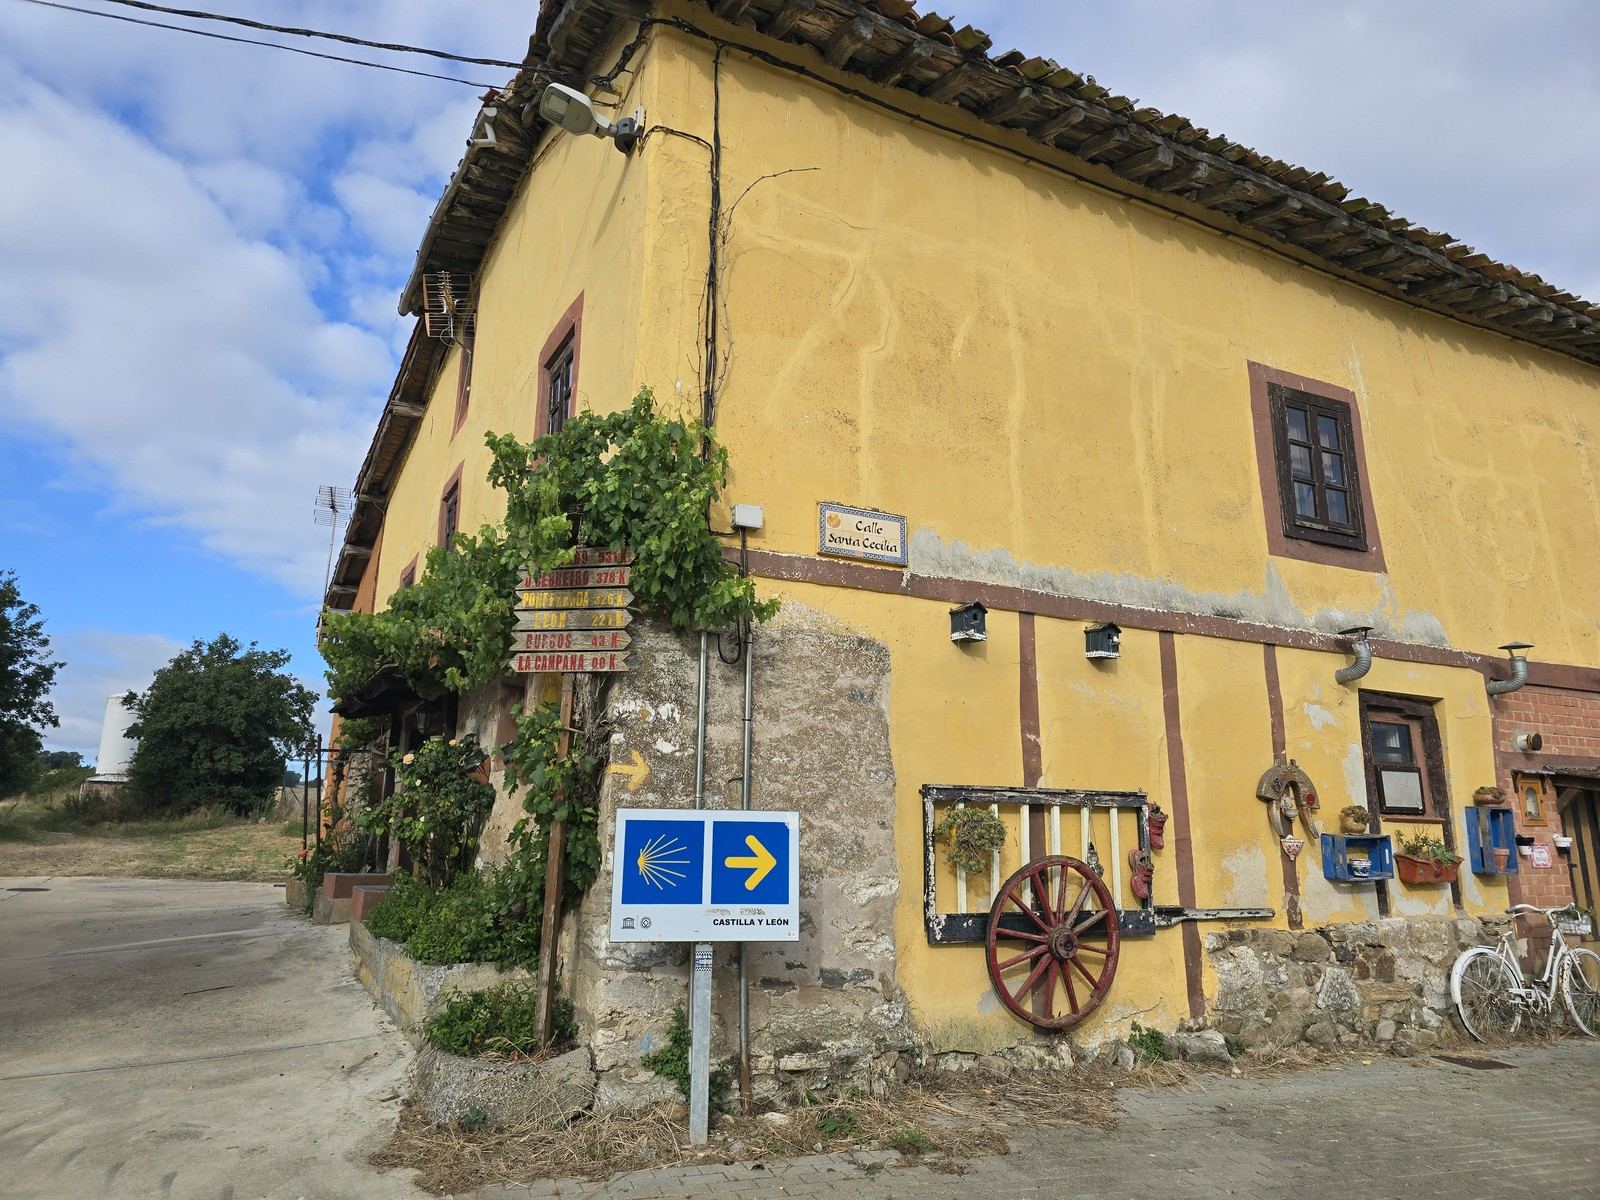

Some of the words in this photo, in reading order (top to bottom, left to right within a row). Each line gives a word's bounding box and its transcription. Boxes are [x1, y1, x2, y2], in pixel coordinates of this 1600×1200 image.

[856, 520, 883, 535] Calle
[828, 533, 861, 547] Santa
[862, 537, 898, 553] Cecilia
[596, 571, 616, 584] 378
[619, 569, 625, 584] K
[617, 591, 624, 605] K
[533, 612, 568, 628] LEON
[592, 613, 613, 627] 221
[616, 611, 623, 626] K
[526, 633, 572, 648] BURGOS
[592, 635, 605, 647] 43
[611, 632, 618, 648] K
[517, 655, 531, 671] LA
[534, 654, 585, 671] CAMPANA
[610, 654, 616, 670] K
[766, 917, 789, 925] LEÓN
